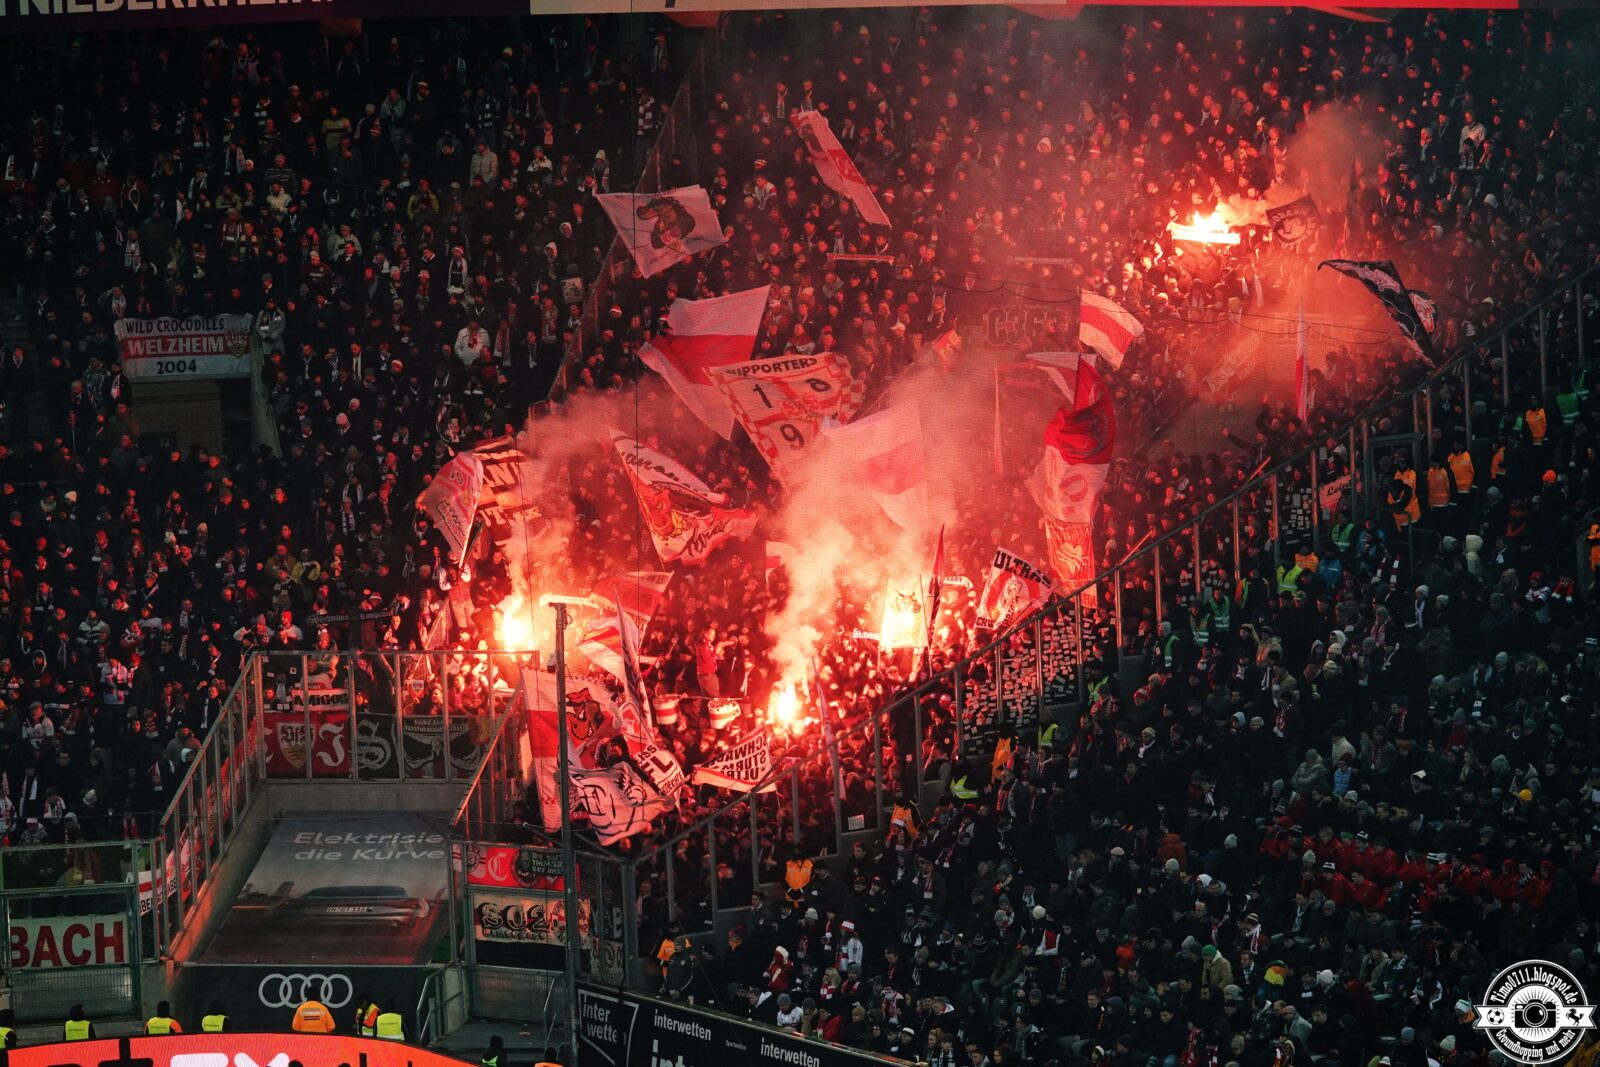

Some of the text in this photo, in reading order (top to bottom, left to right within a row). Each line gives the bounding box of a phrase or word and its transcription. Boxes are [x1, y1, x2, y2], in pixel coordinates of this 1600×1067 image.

[126, 318, 224, 334] WILD CROCODILES
[128, 336, 224, 355] WELZHEIM
[156, 360, 197, 374] 2004
[295, 849, 342, 860] die
[583, 994, 611, 1022] inter
[654, 1009, 712, 1041] interwetten
[760, 1037, 820, 1067] interwetten
